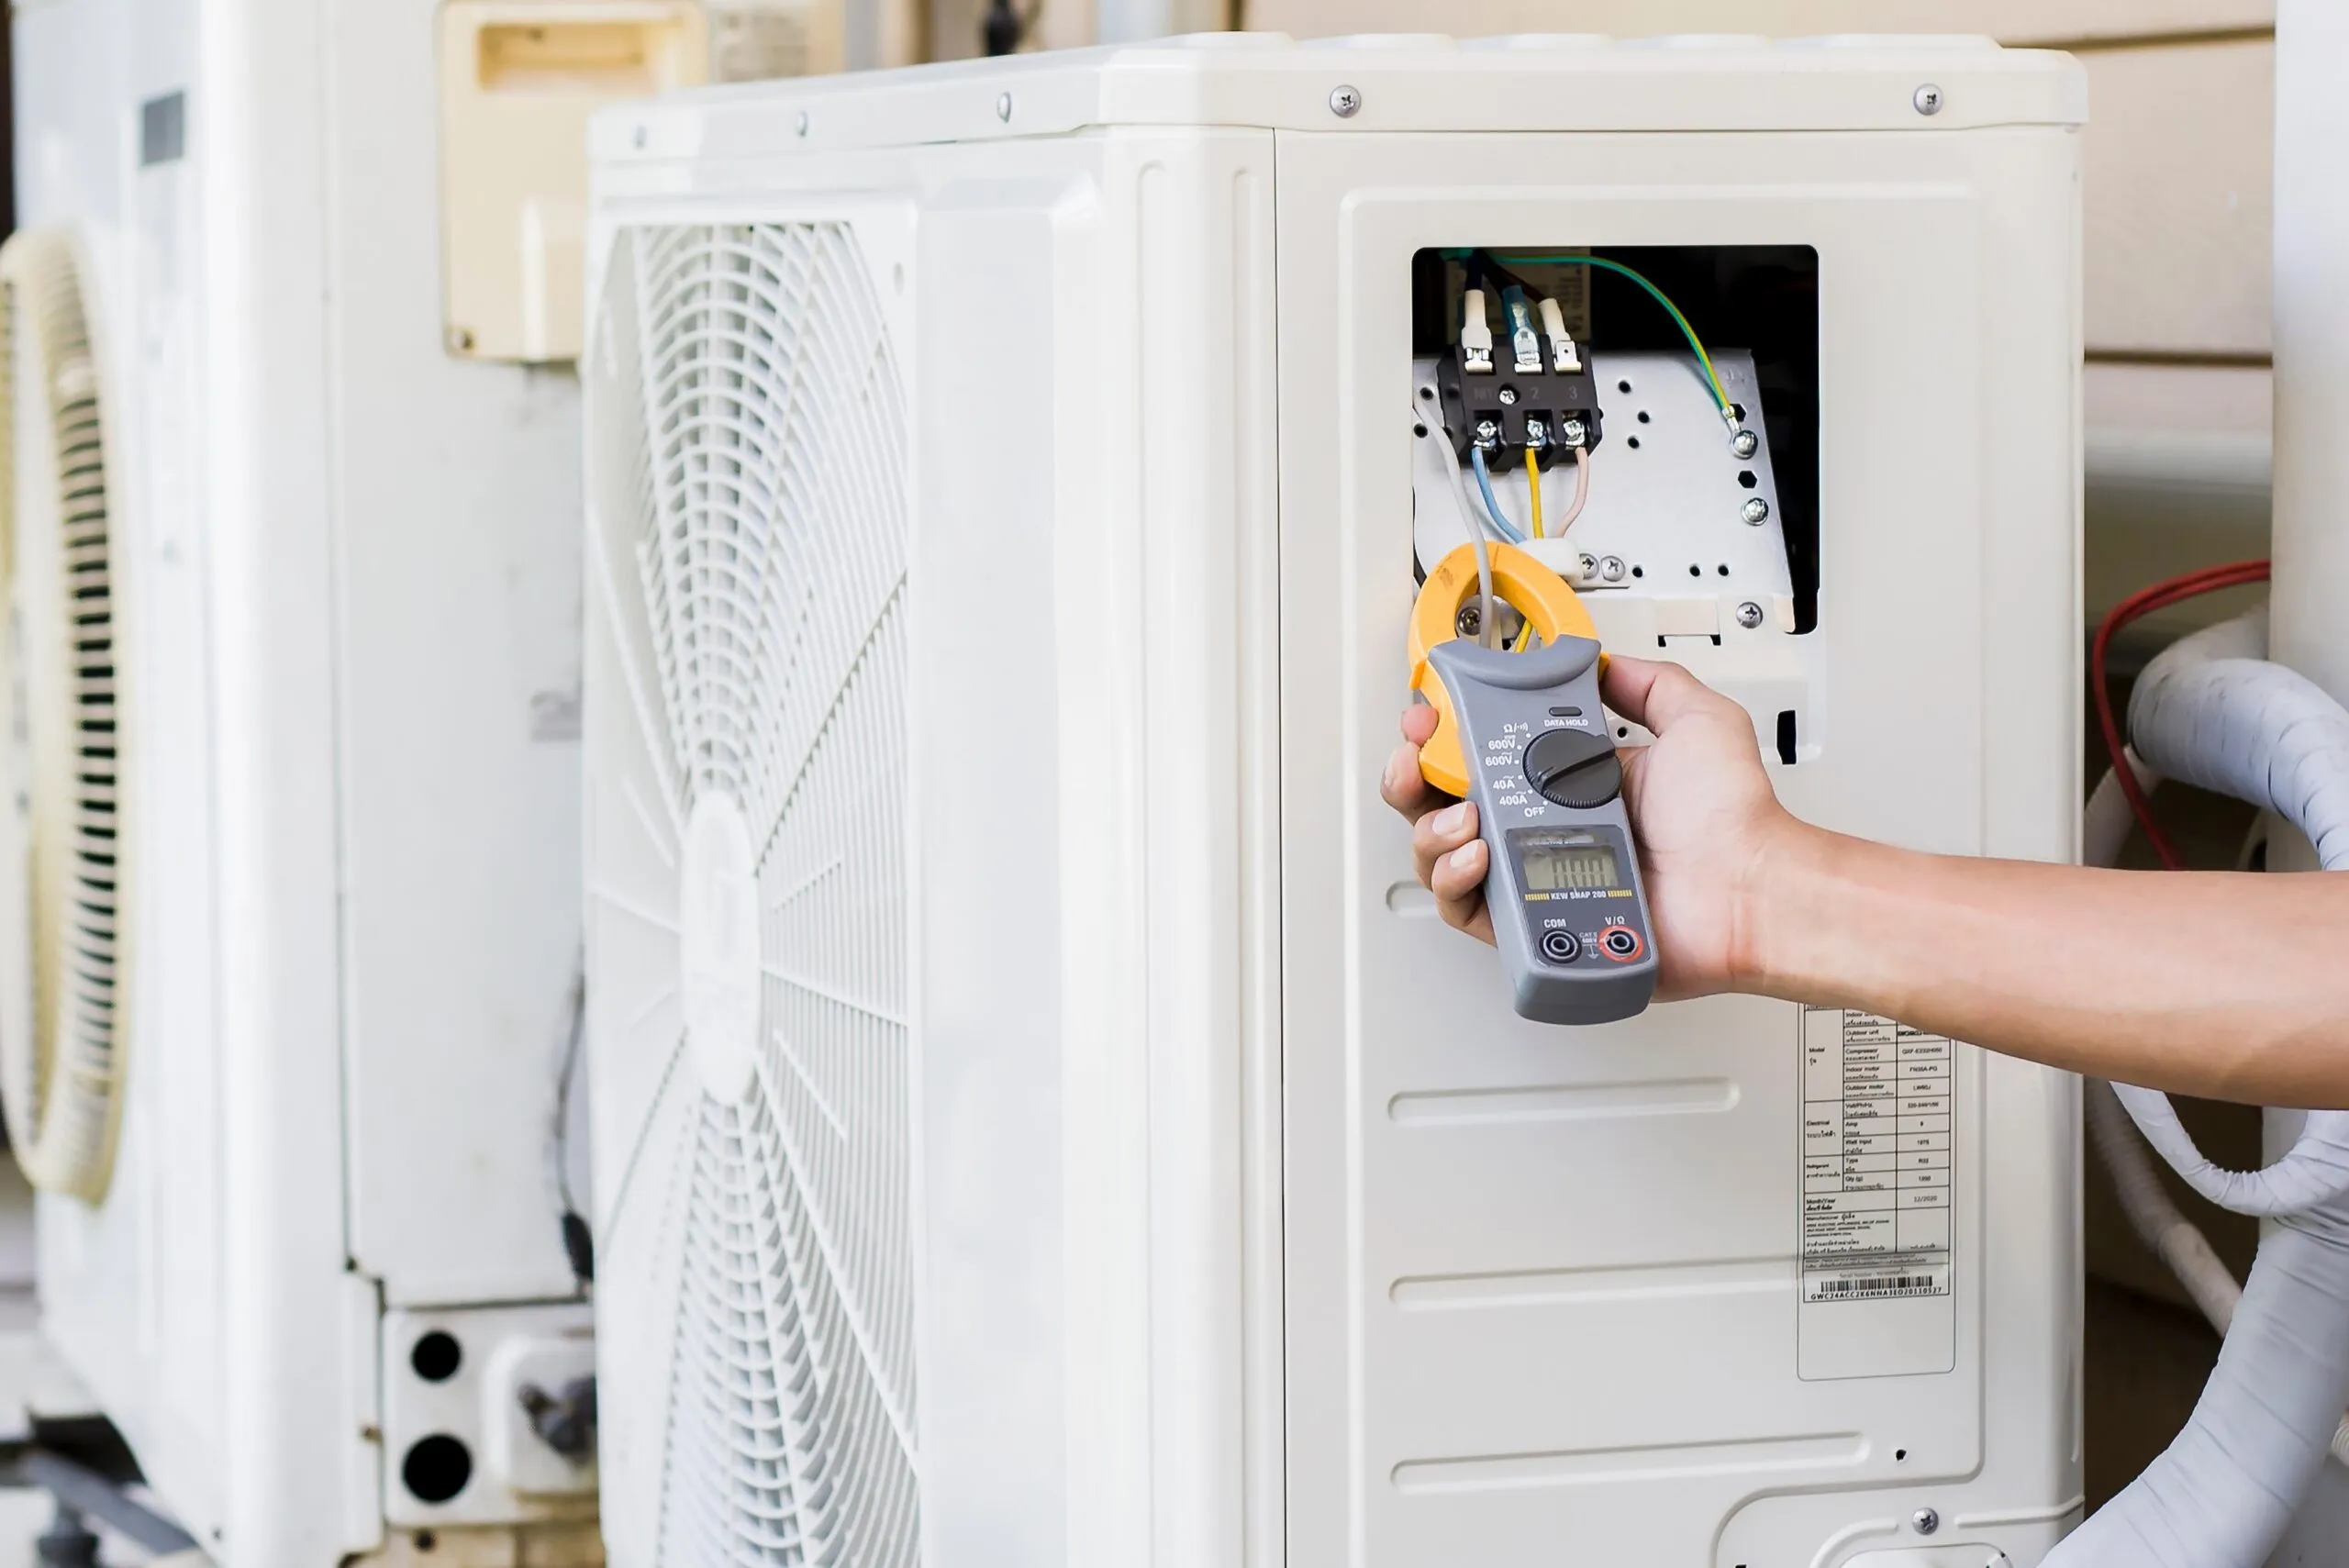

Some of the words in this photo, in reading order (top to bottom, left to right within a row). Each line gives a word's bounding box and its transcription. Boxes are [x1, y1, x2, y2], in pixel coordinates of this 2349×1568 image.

[1530, 386, 1540, 399] 2
[1567, 385, 1578, 399] 3
[1544, 718, 1564, 727] DATA
[1565, 718, 1588, 727] HOLD
[1487, 739, 1516, 751] 600V
[1485, 755, 1513, 767] 600V
[1492, 779, 1516, 790] 40A
[1498, 795, 1528, 806] 400A
[1523, 806, 1545, 817] OFF
[1550, 892, 1568, 900] KEW
[1569, 891, 1591, 899] SNAP
[1591, 890, 1607, 898] 200
[1543, 918, 1567, 929] COM
